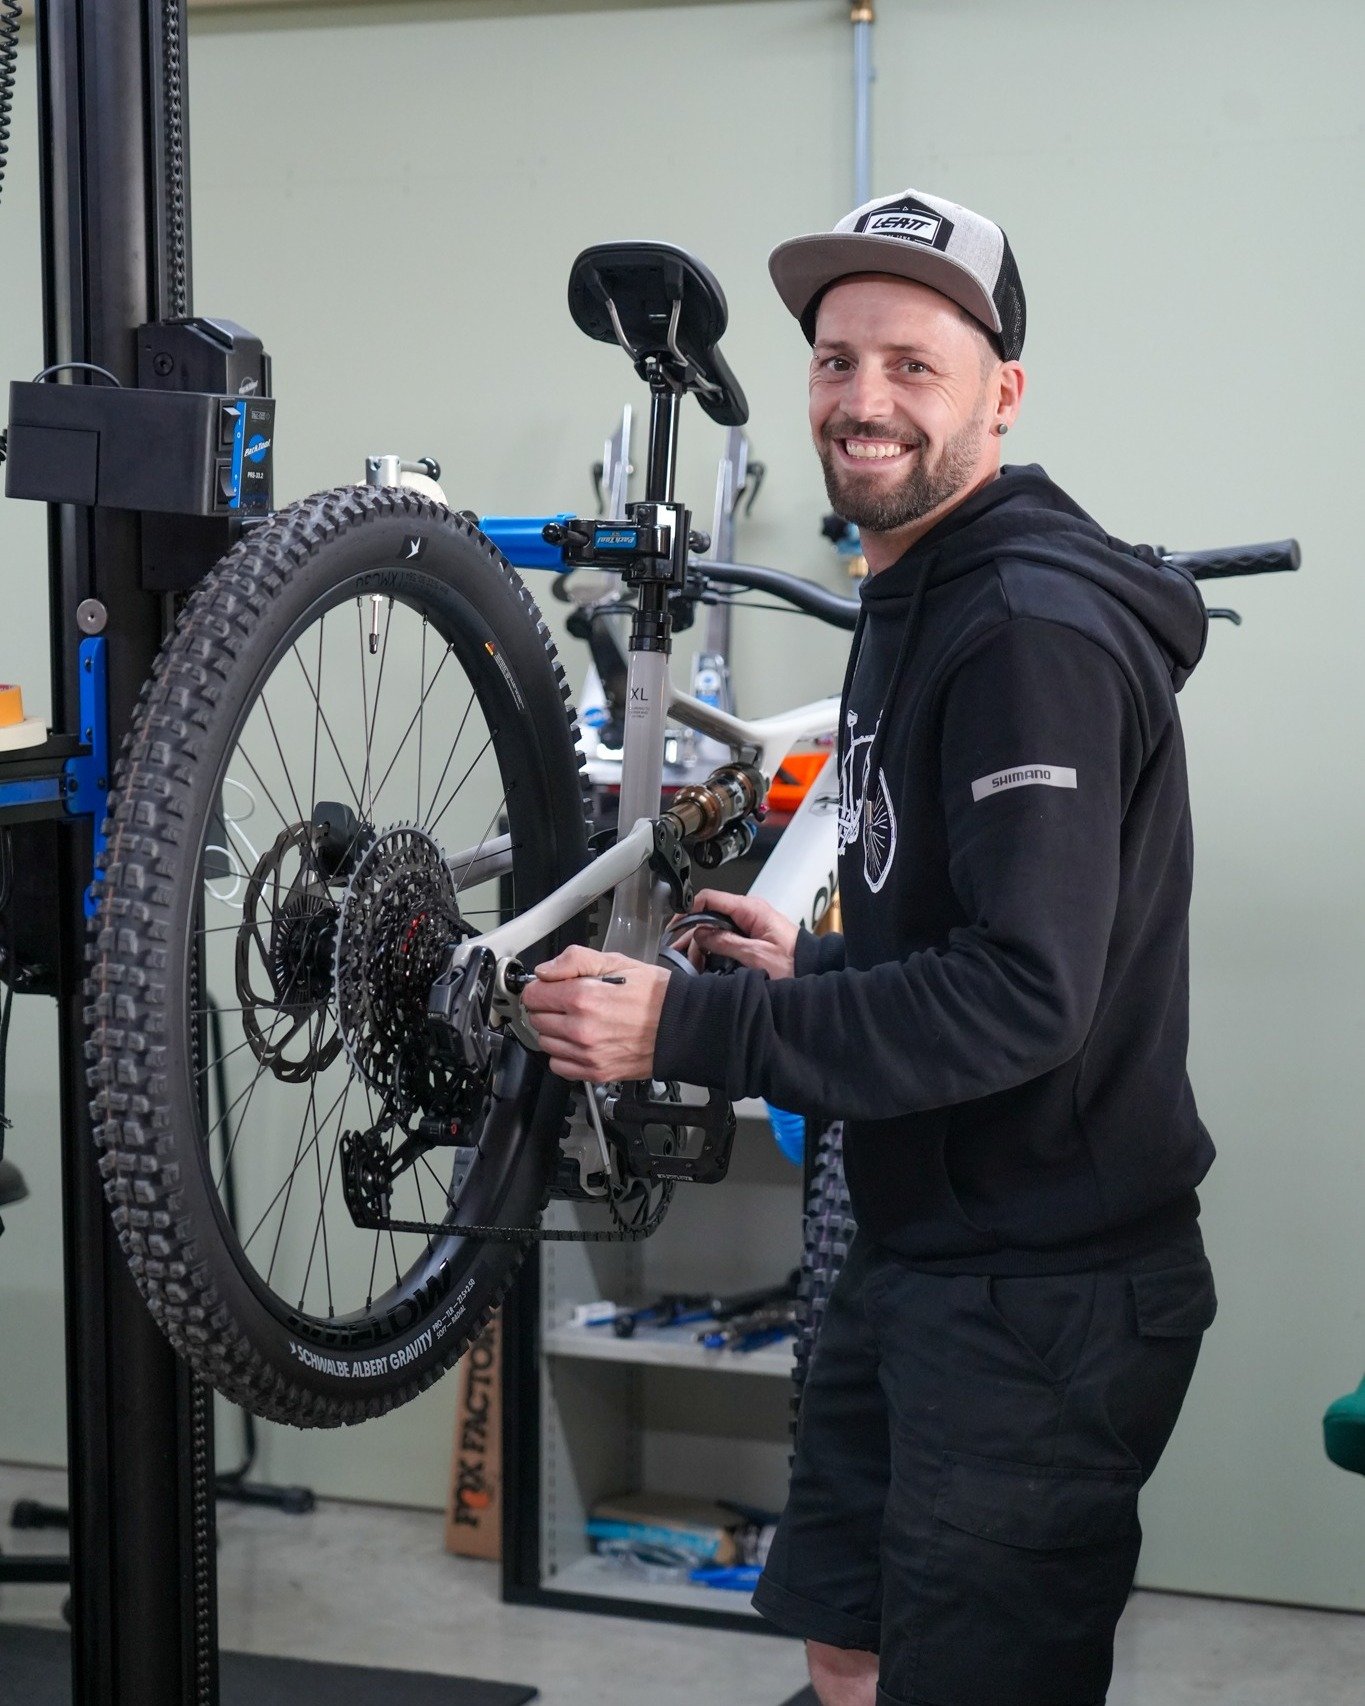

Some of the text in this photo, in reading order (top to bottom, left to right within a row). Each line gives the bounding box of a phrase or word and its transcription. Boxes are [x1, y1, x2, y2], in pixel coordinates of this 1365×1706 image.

[871, 217, 931, 231] LEATT
[631, 688, 648, 701] XL
[992, 769, 1051, 788] SHIMANO
[436, 1325, 448, 1340] SOFT
[297, 1344, 351, 1378] SCHWALBE
[351, 1356, 390, 1379] ALBERT
[389, 1329, 434, 1370] GRAVITY
[432, 1319, 443, 1332] PRO
[445, 1306, 455, 1318] TLR
